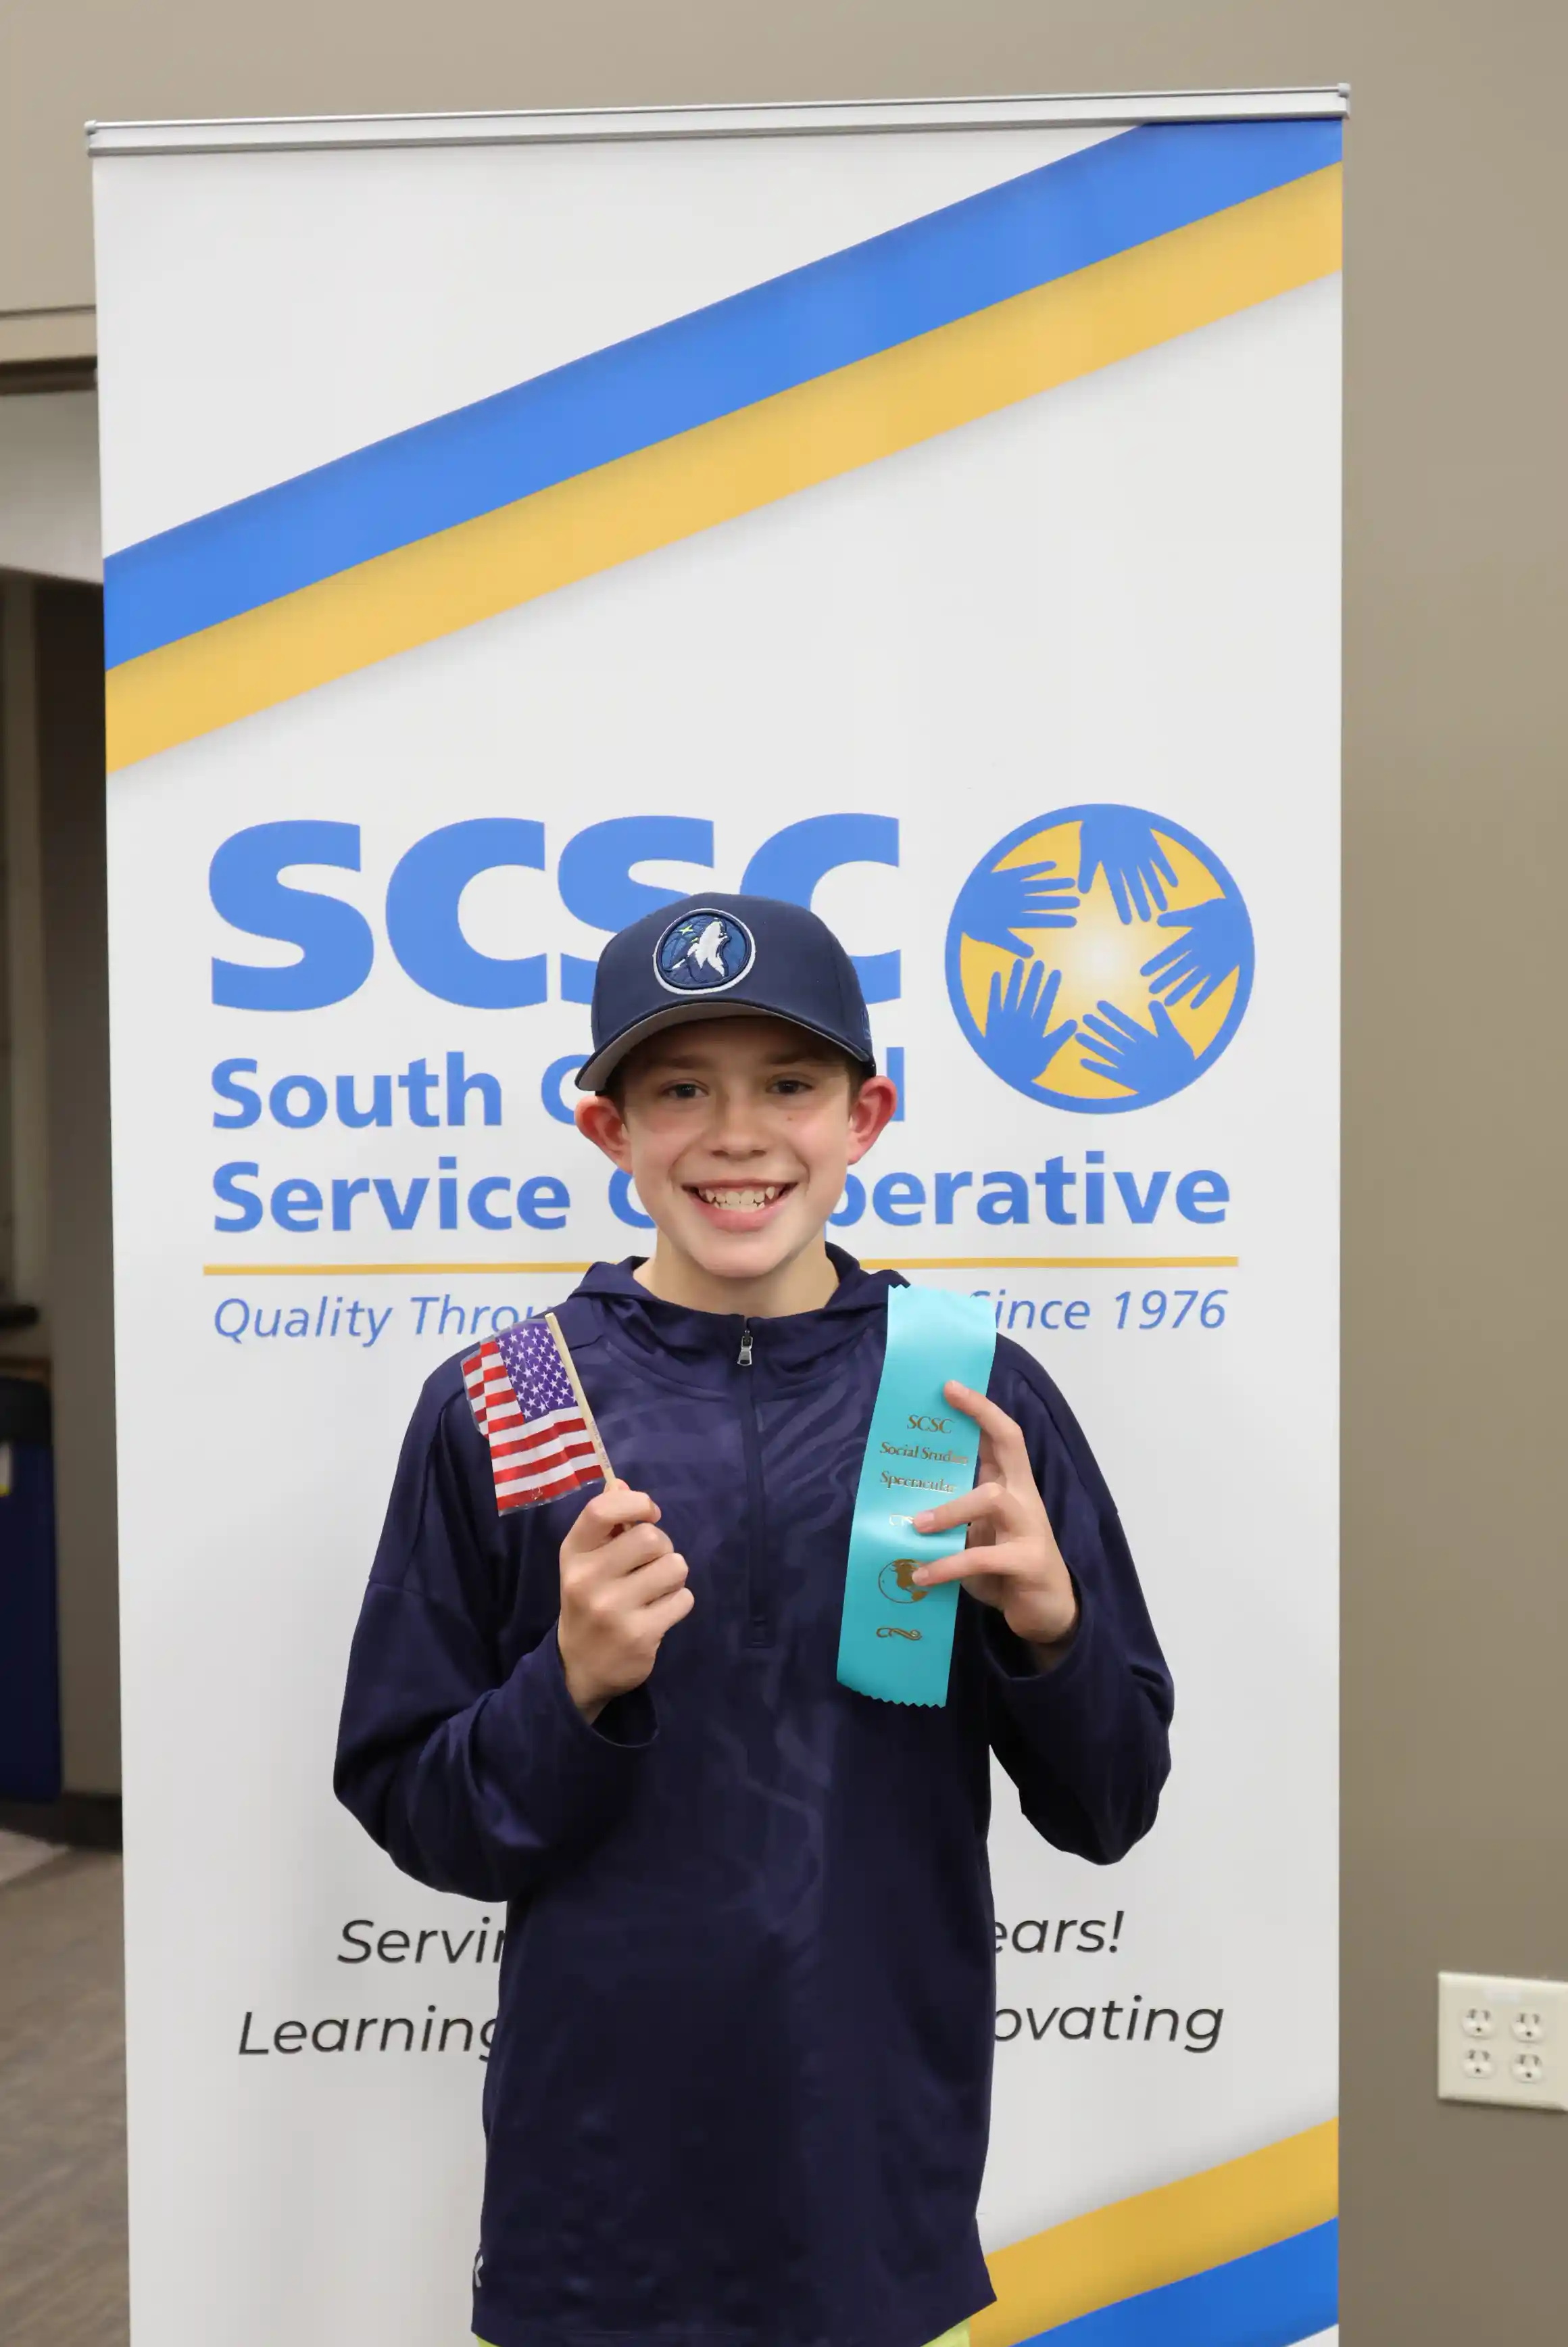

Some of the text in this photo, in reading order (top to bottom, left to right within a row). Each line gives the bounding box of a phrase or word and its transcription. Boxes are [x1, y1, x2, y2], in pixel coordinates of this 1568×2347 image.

[209, 813, 901, 1012] SCSC
[212, 1051, 502, 1129] South
[213, 1156, 570, 1232] Service
[214, 1289, 1229, 1347] Quality Thro ince 1976
[880, 1441, 918, 1457] Social
[907, 1414, 954, 1434] SCSC
[880, 1470, 956, 1493] Spectacular
[995, 1995, 1223, 2053] ovating
